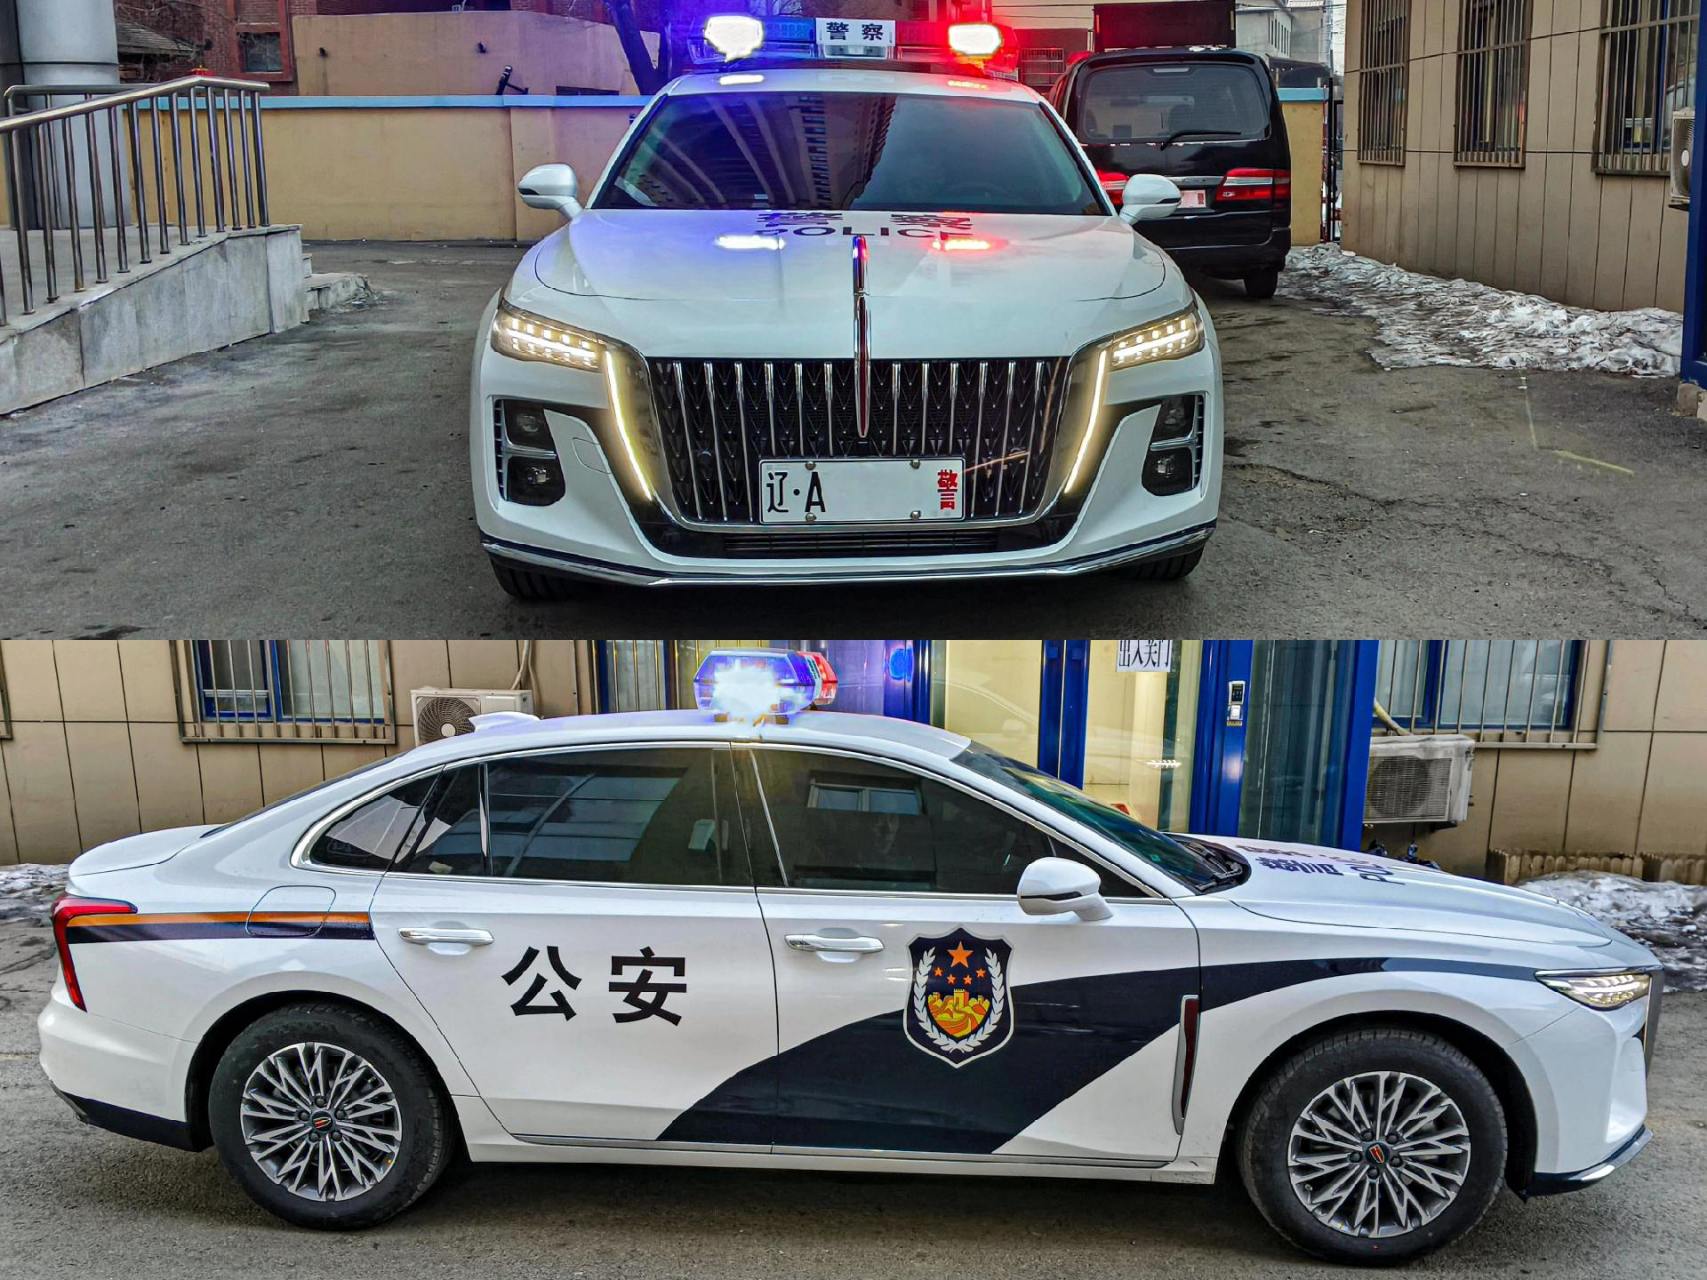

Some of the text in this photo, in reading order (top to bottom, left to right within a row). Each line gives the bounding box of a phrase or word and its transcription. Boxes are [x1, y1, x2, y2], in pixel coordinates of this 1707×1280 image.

[826, 22, 884, 41] 警察
[936, 468, 958, 510] 警
[501, 945, 687, 1026] 公安
